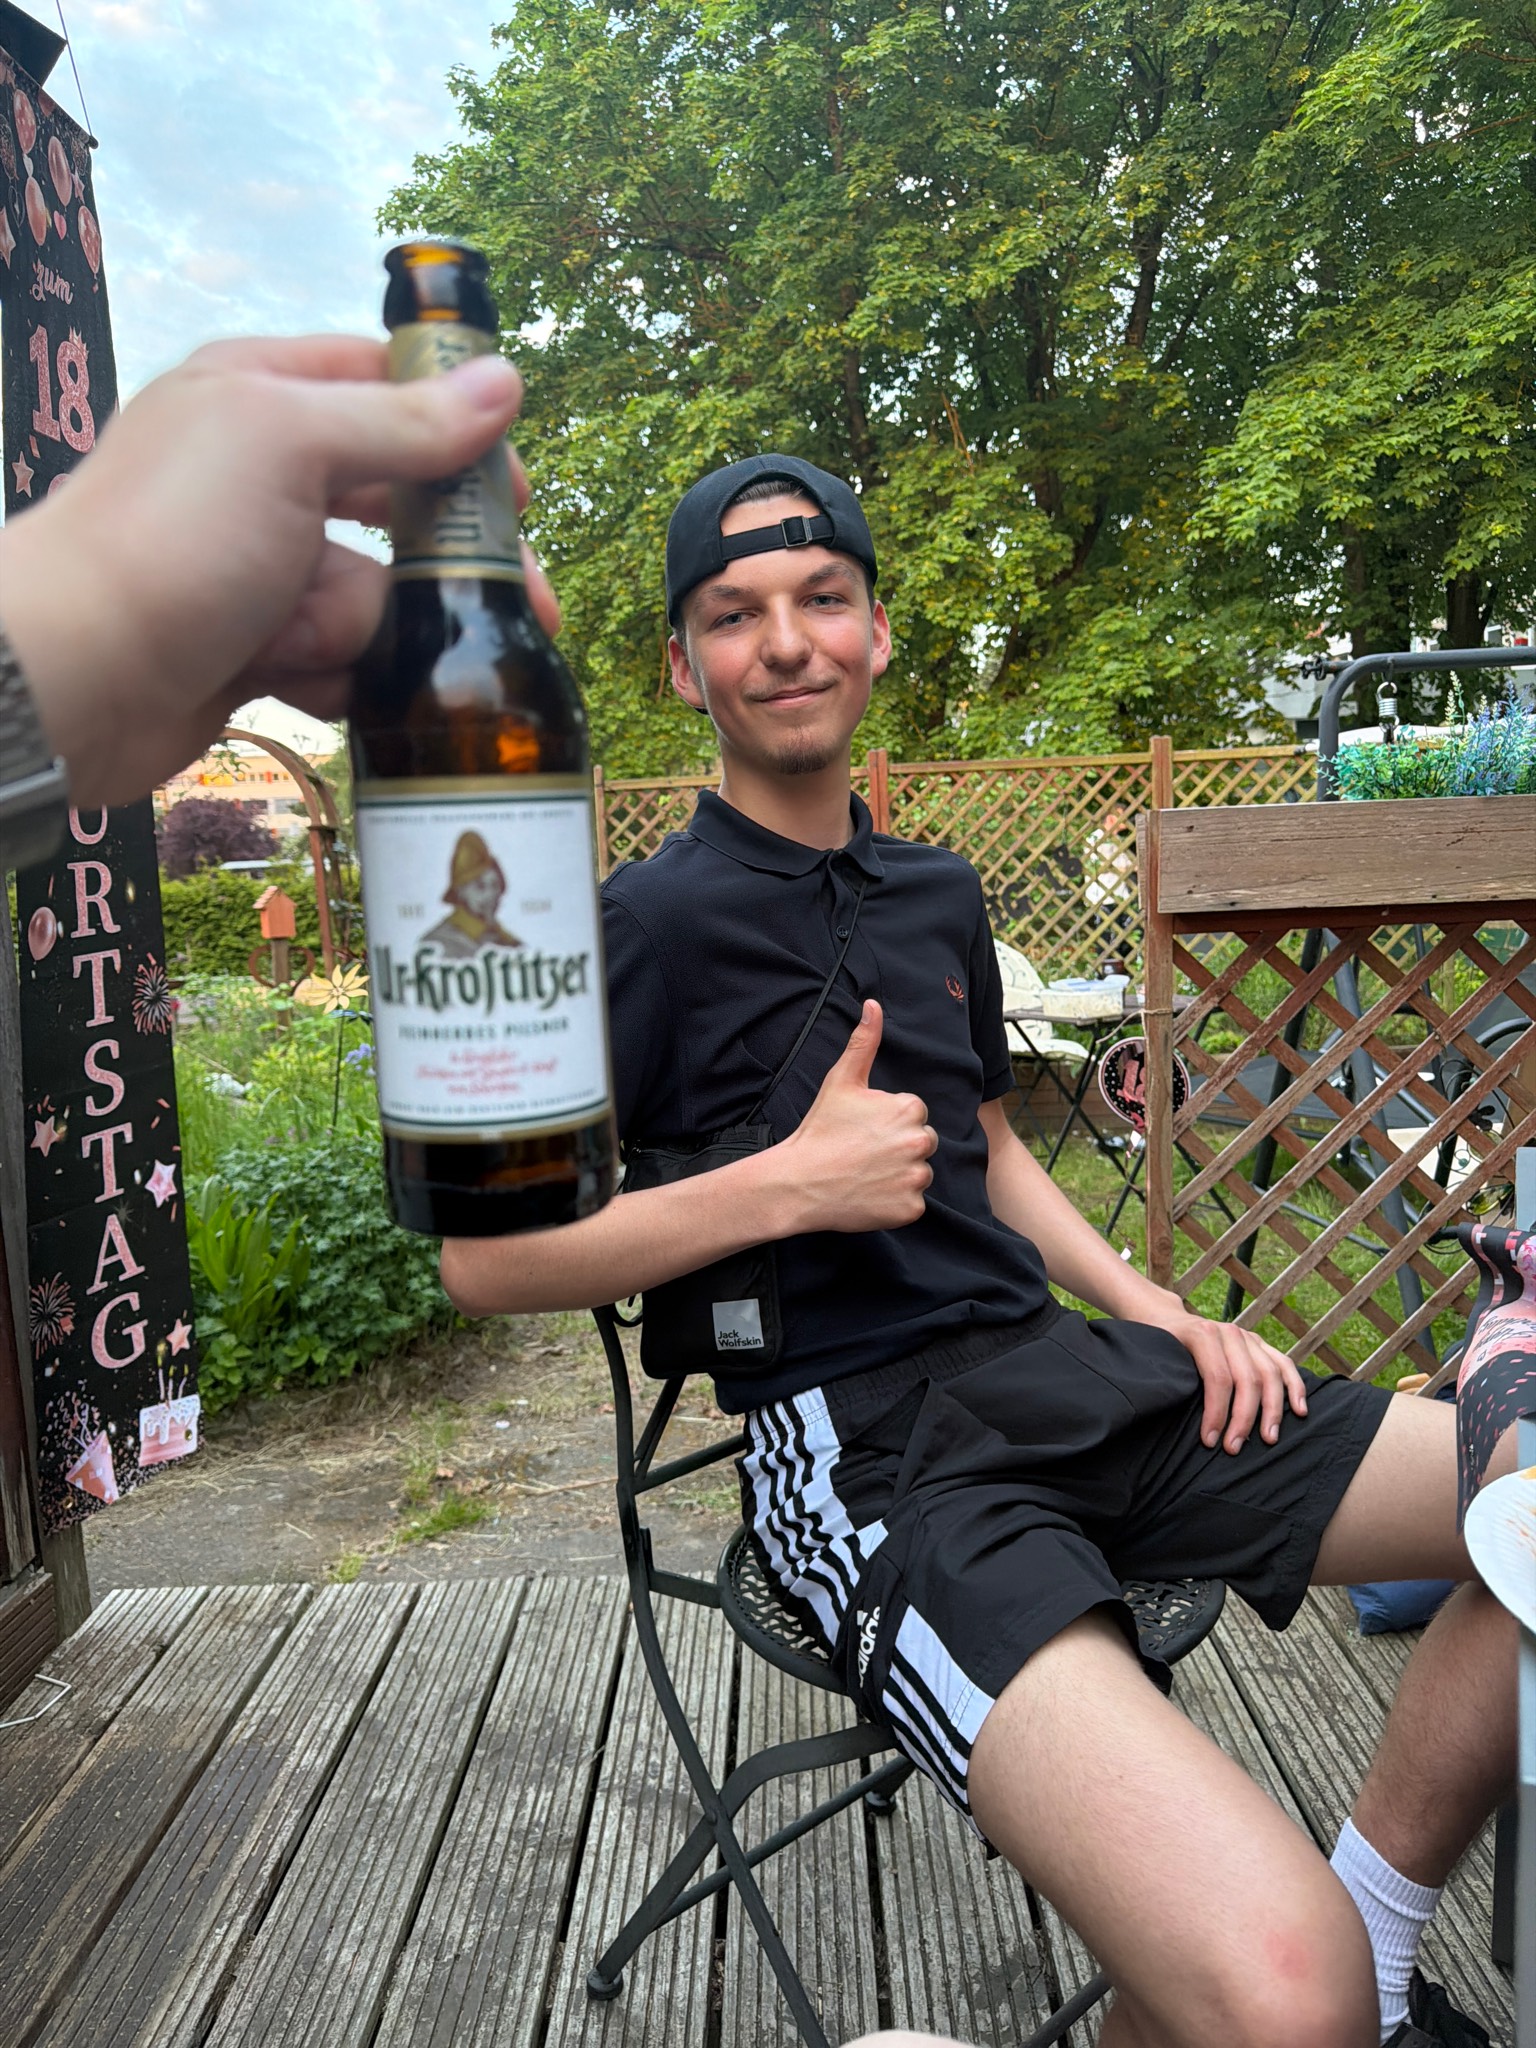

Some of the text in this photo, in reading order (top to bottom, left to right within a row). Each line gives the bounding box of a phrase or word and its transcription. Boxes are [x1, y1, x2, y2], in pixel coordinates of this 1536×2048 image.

[32, 258, 73, 304] zum
[29, 324, 95, 454] 18
[717, 1329, 739, 1340] Jack
[719, 1336, 762, 1348] Wolfskin
